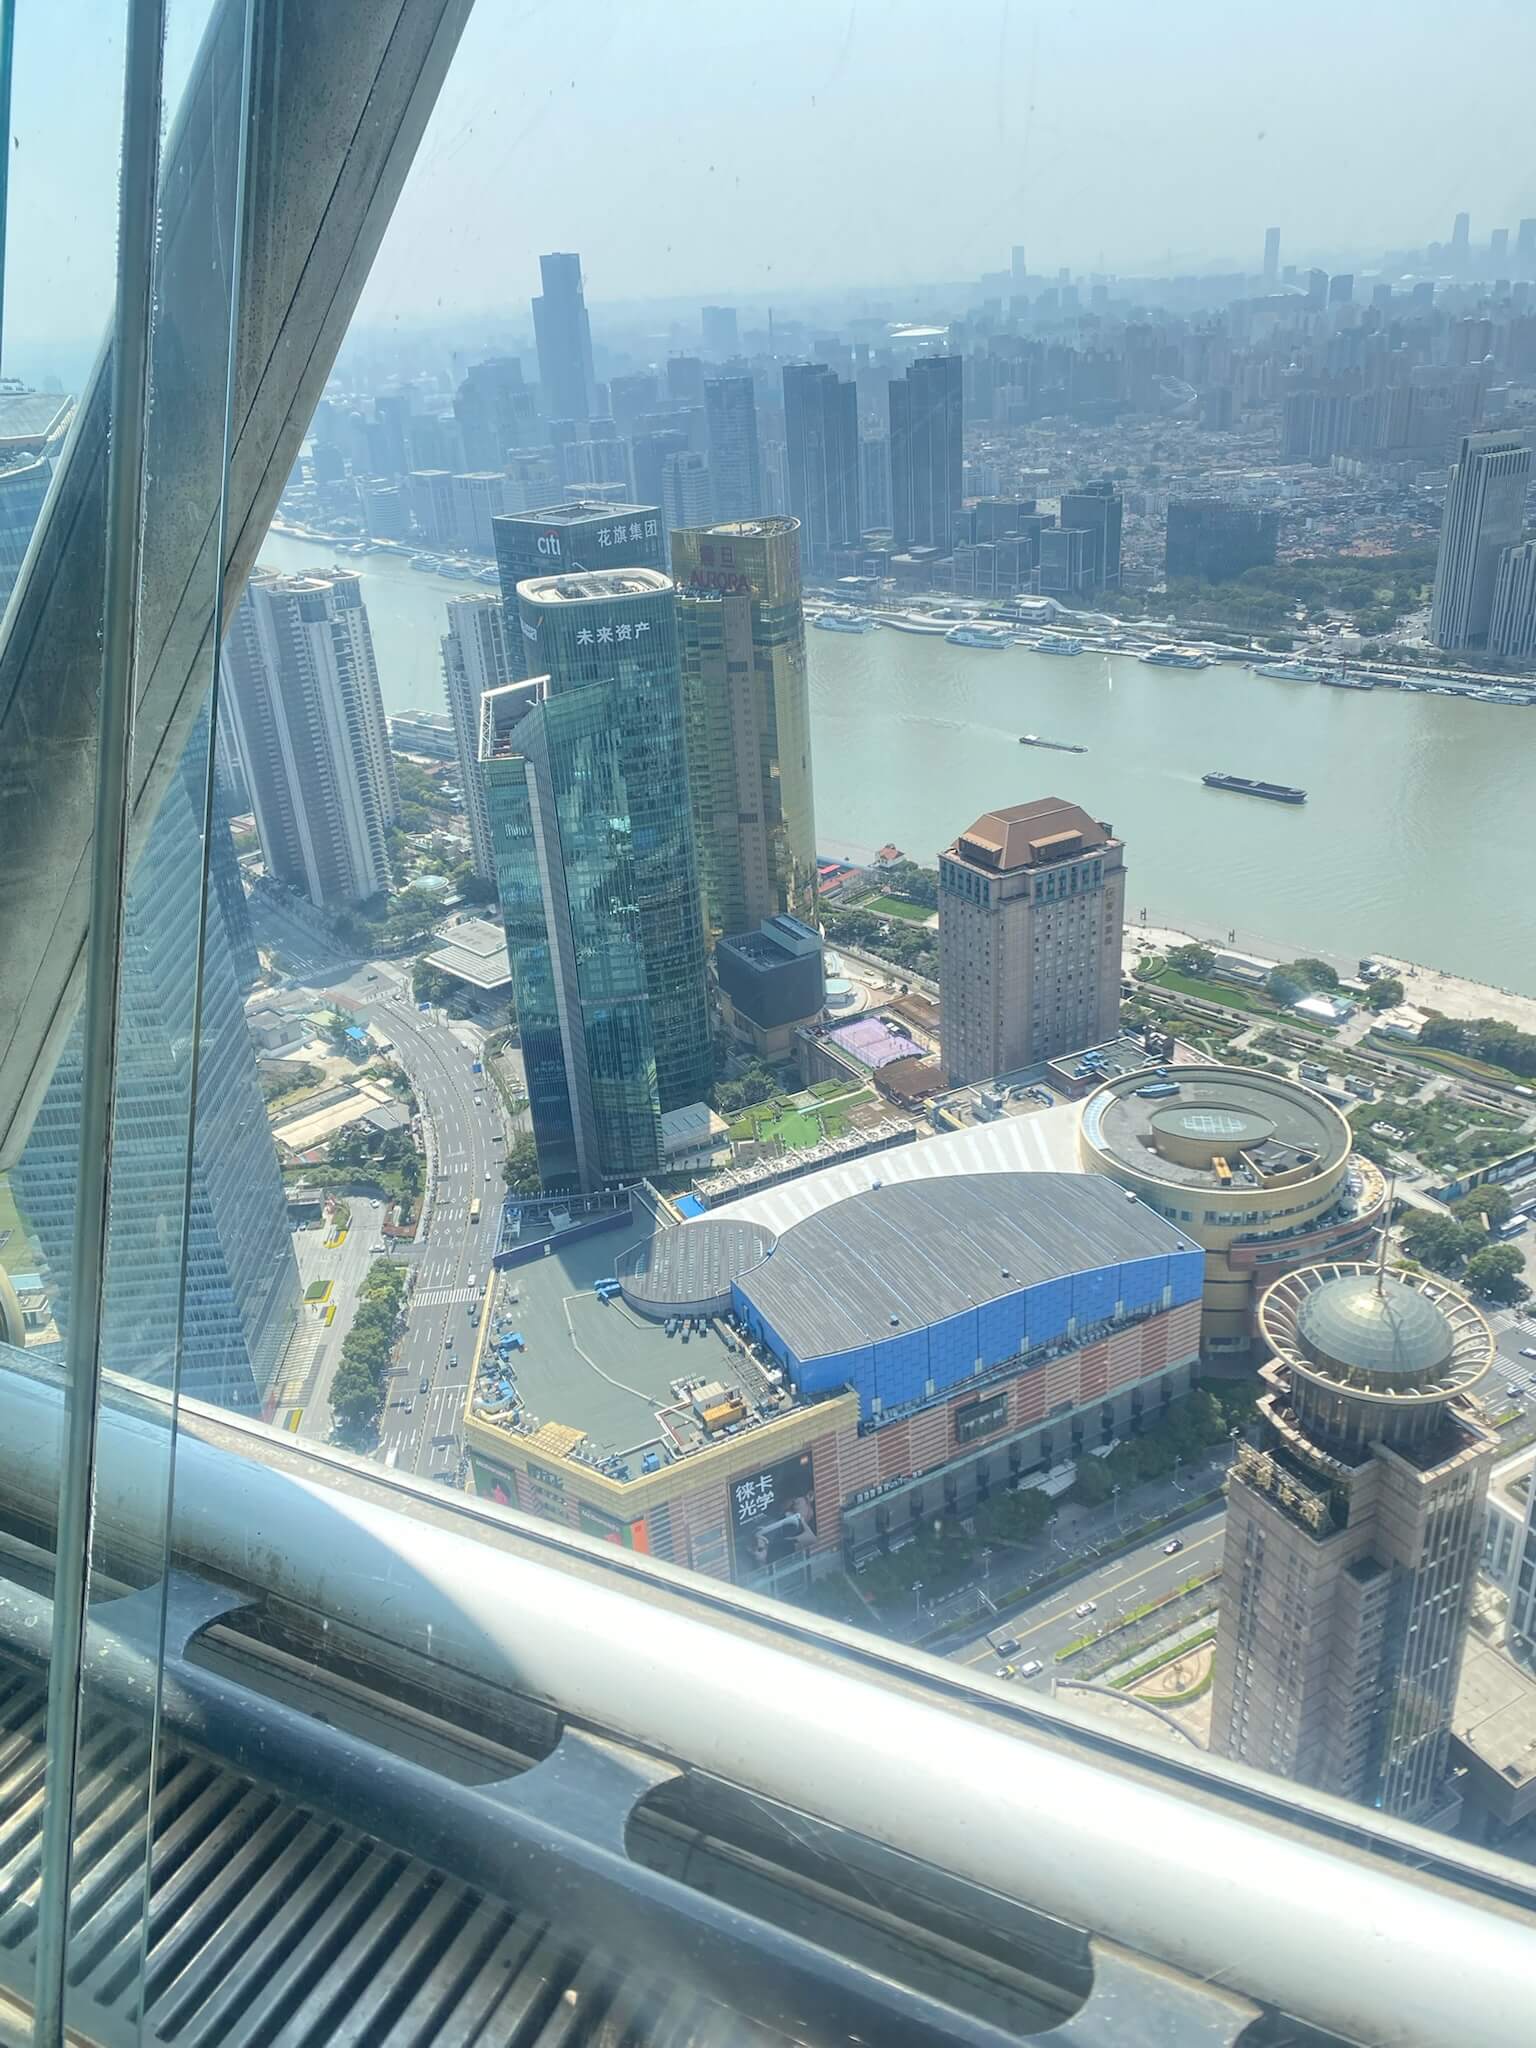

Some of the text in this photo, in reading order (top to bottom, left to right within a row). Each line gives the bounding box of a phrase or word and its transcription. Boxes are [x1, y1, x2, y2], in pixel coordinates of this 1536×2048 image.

[537, 534, 561, 556] citi
[597, 519, 658, 548] 花旗集团
[691, 569, 751, 593] AURORA
[577, 622, 651, 645] 未来资产
[736, 1474, 774, 1503] 徕卡
[738, 1491, 775, 1520] 光学
